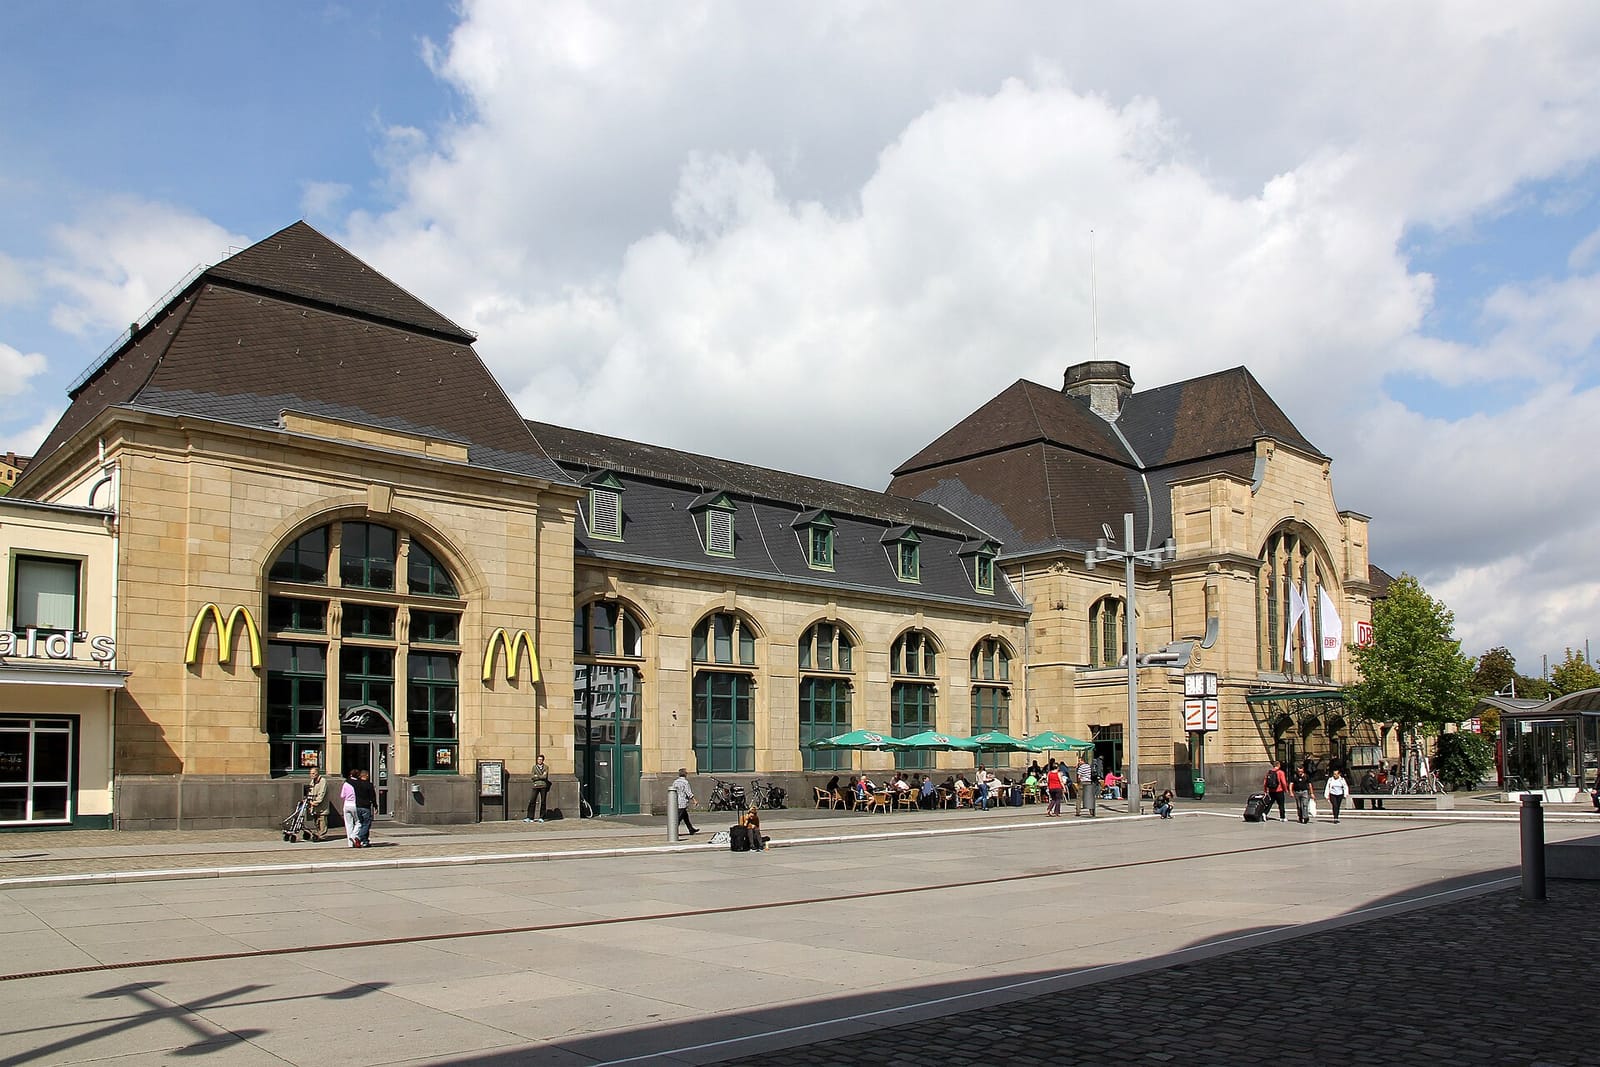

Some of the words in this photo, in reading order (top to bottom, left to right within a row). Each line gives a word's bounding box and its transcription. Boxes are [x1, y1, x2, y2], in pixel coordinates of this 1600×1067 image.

[1324, 638, 1335, 647] DB
[1359, 625, 1373, 644] DB
[0, 628, 117, 661] ald's
